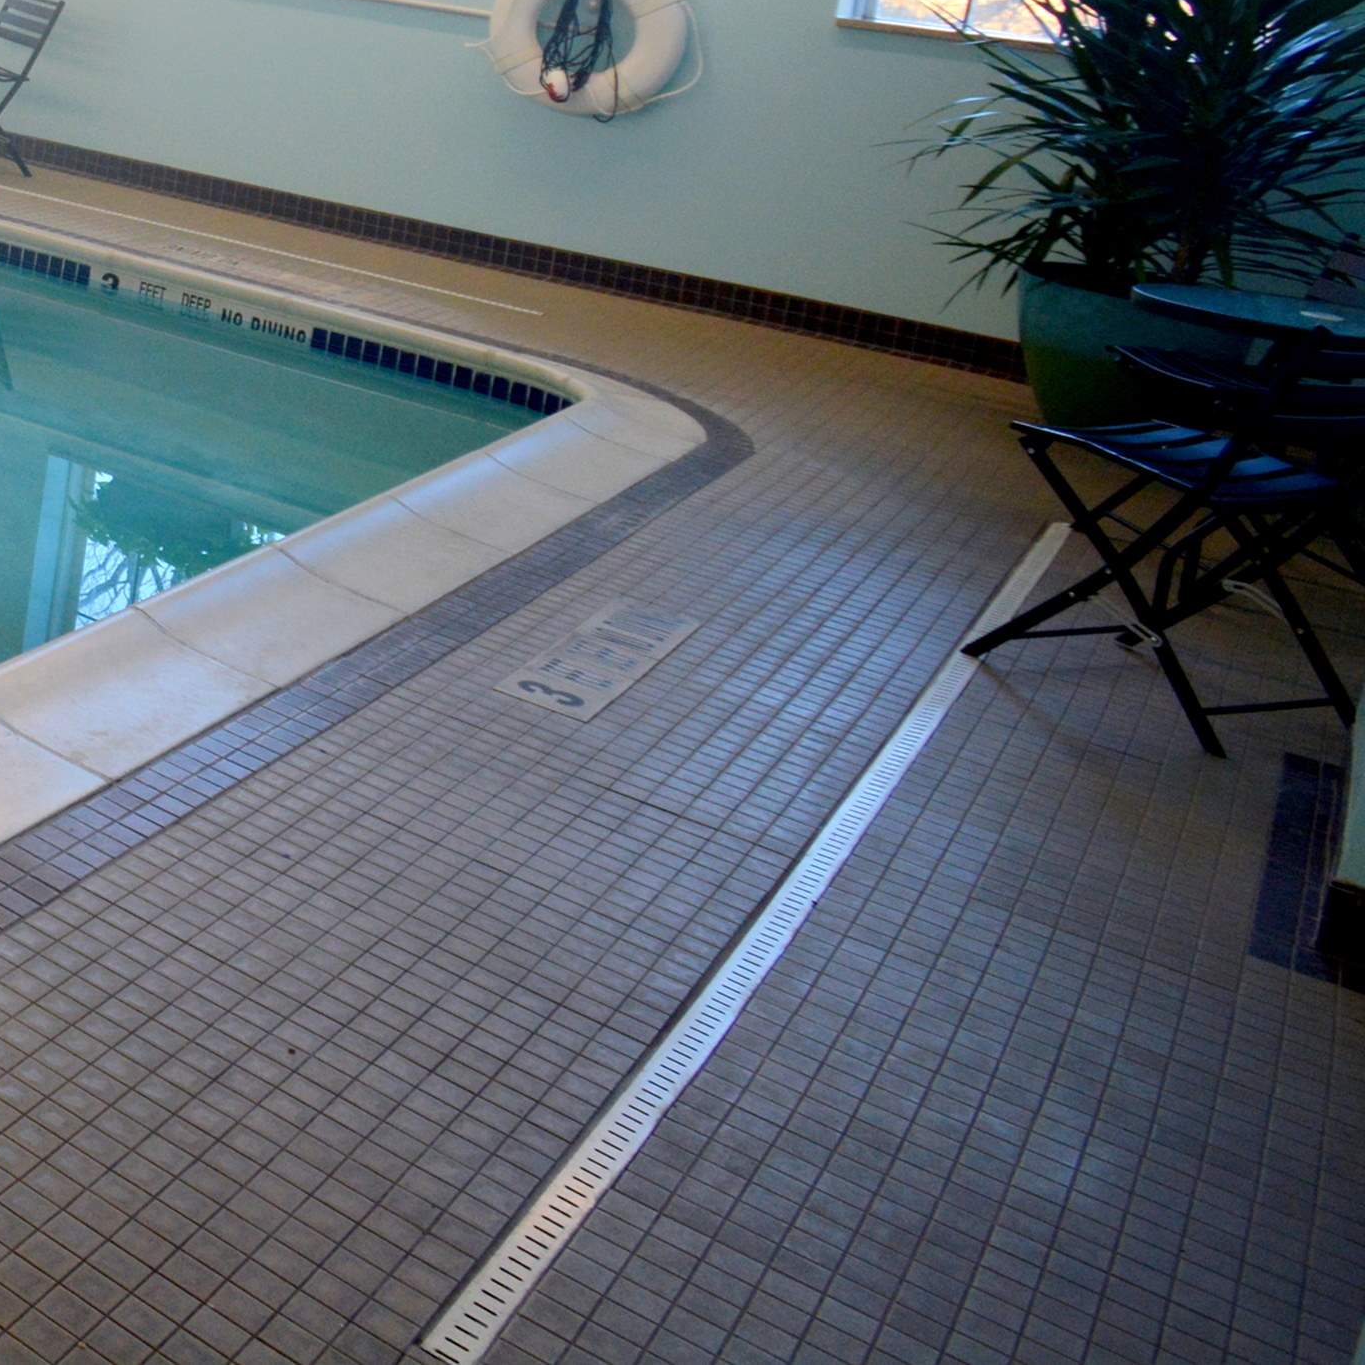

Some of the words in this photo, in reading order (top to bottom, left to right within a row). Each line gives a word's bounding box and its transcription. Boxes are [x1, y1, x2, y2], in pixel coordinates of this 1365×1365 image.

[221, 307, 243, 326] NO
[250, 316, 307, 343] DIVING
[518, 680, 585, 708] 3
